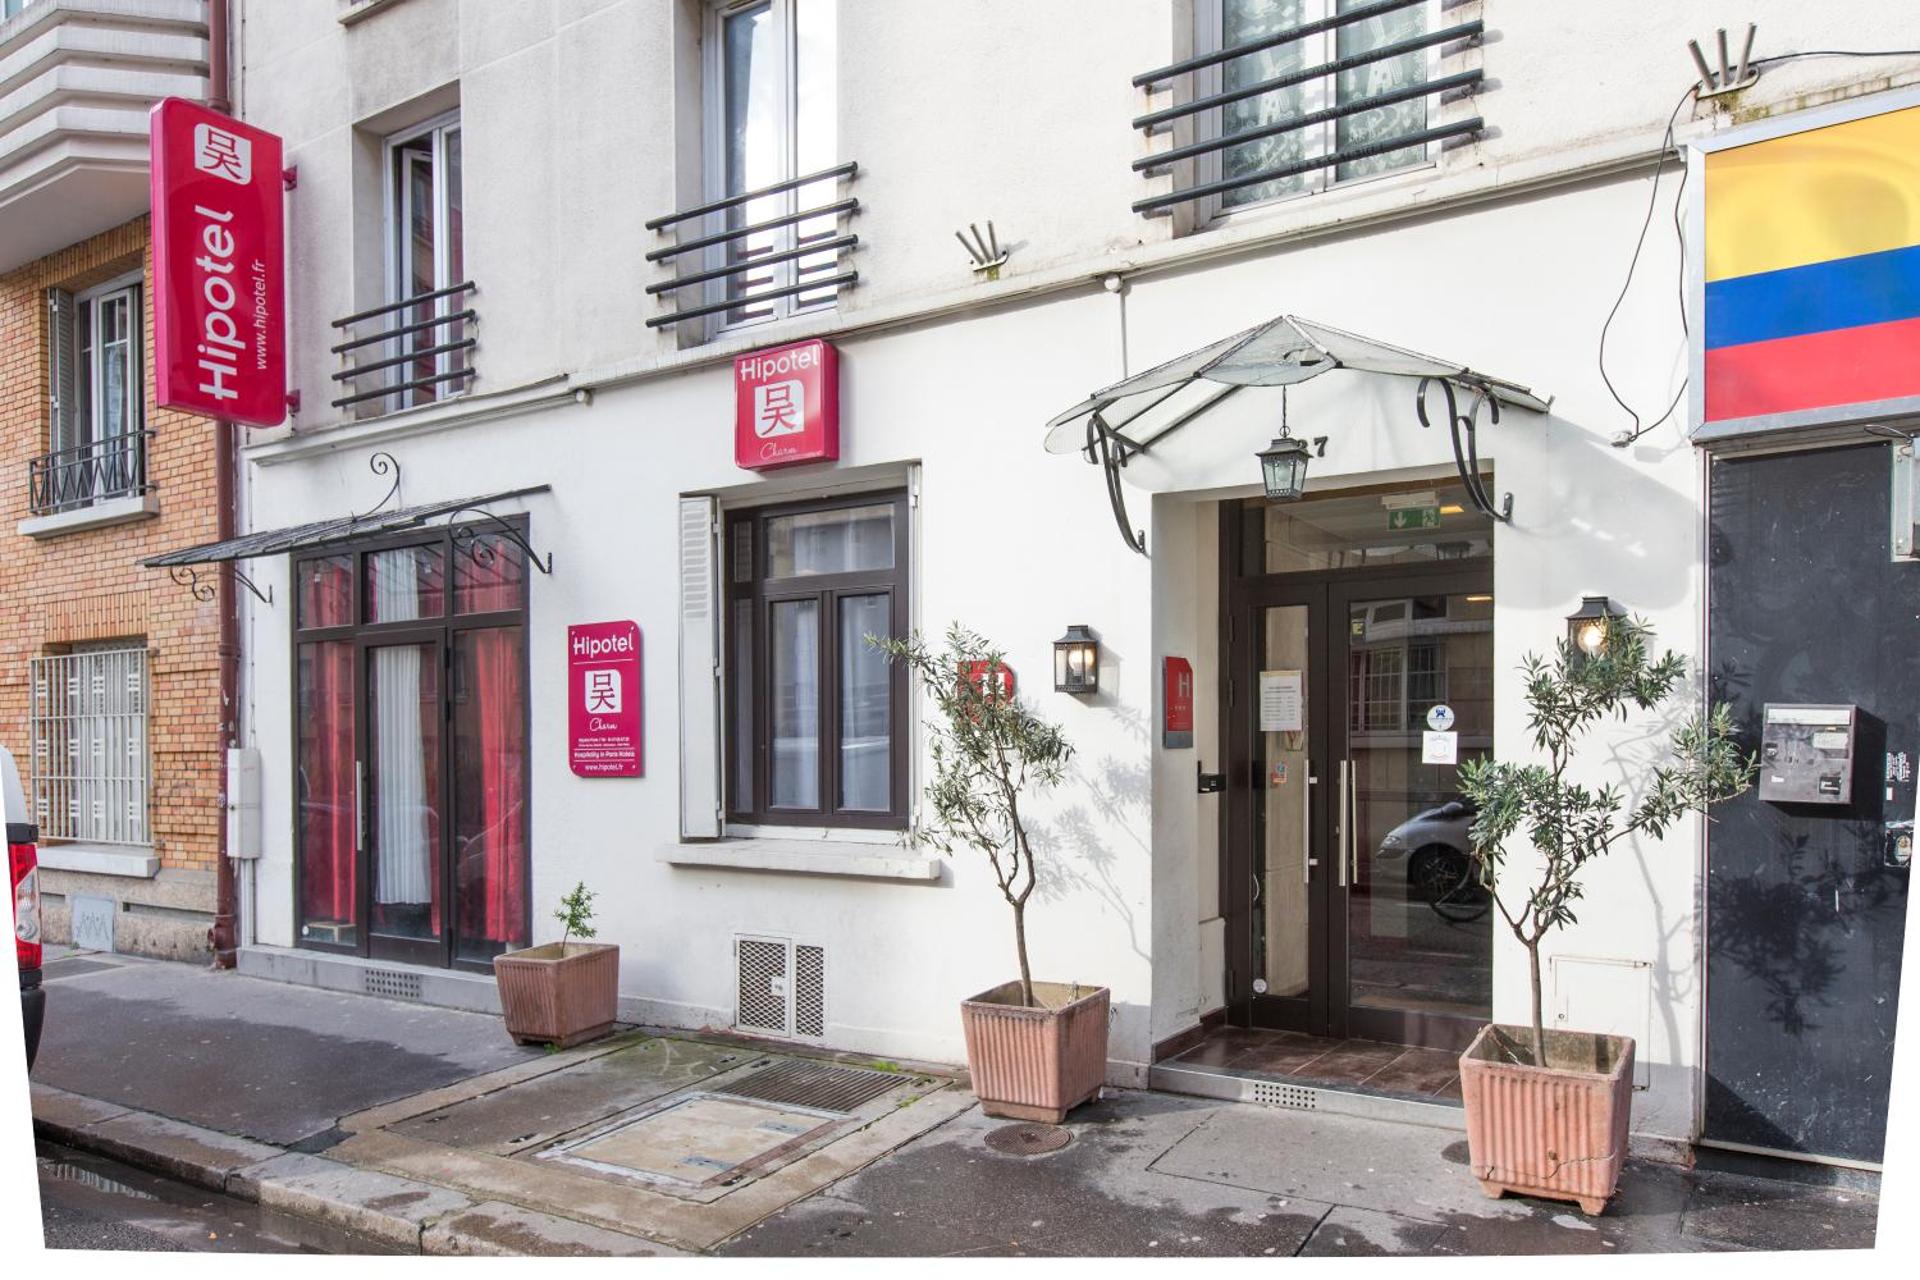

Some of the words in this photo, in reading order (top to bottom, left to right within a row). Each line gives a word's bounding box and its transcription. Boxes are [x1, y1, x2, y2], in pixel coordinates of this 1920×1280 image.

[194, 204, 246, 401] Hipotel
[251, 259, 267, 371] www.hipotel.fr
[741, 346, 819, 382] Hipotel
[573, 633, 633, 658] Hipotel
[1178, 671, 1191, 698] H
